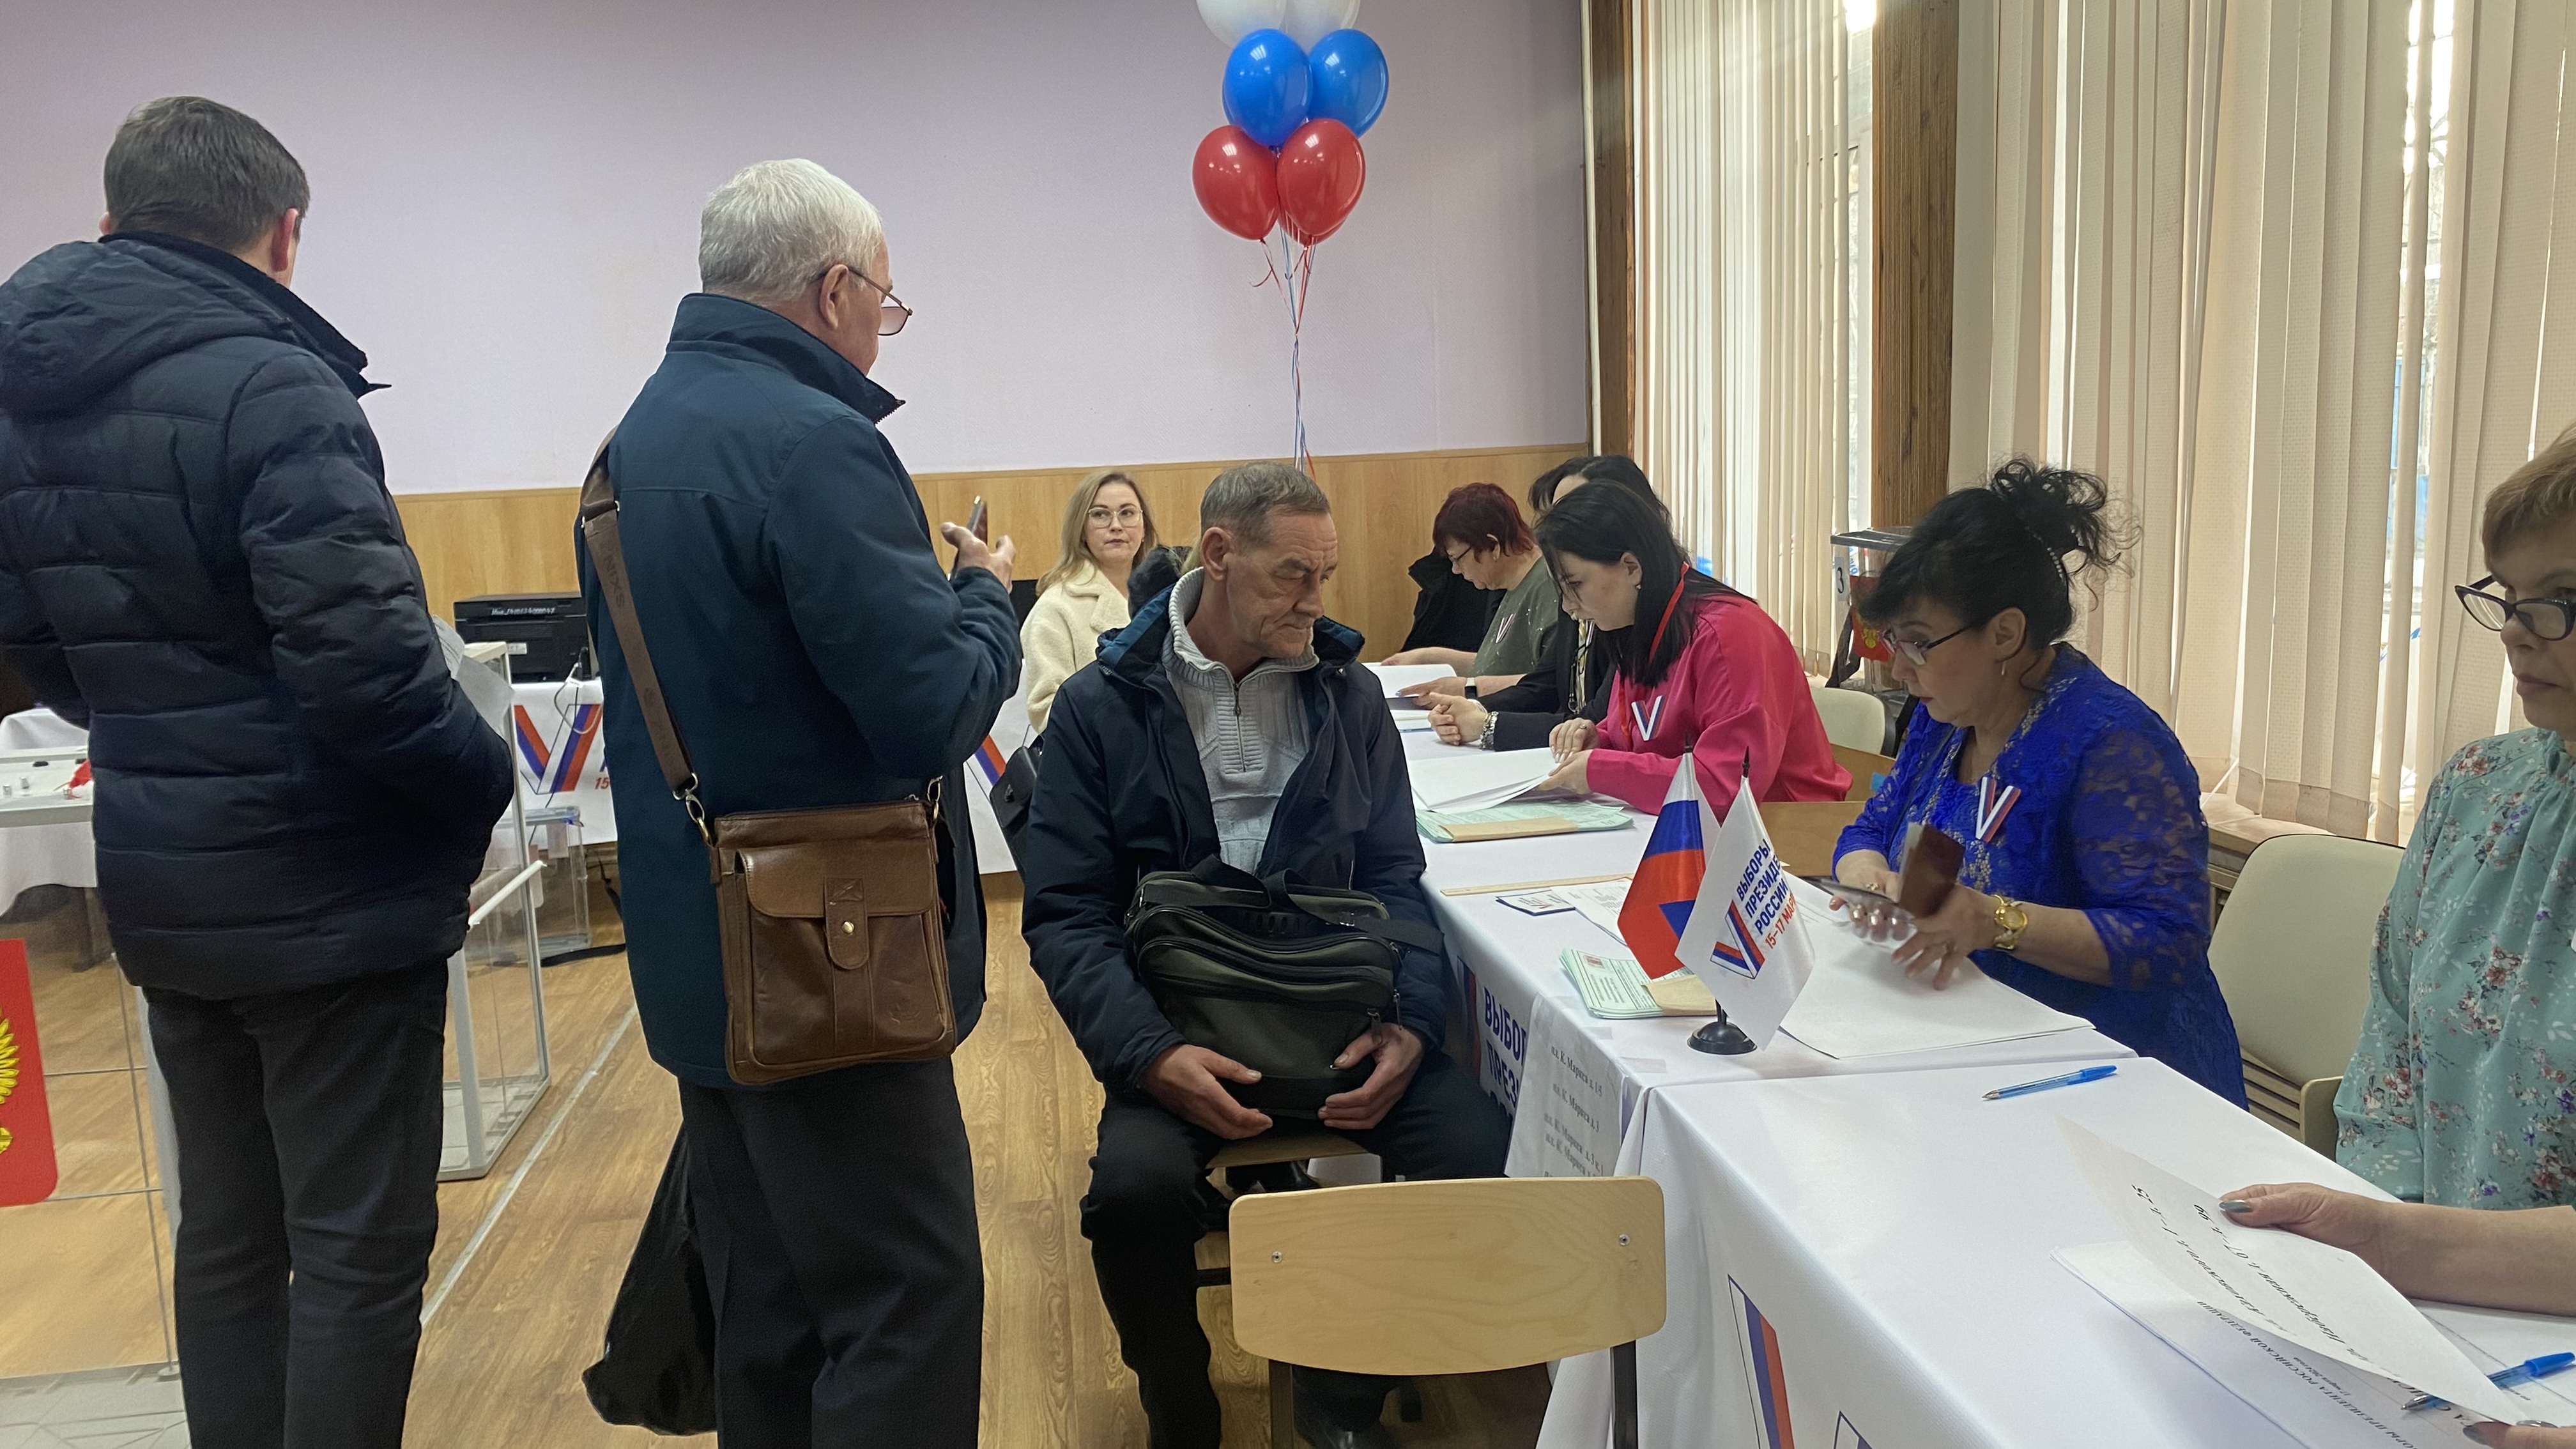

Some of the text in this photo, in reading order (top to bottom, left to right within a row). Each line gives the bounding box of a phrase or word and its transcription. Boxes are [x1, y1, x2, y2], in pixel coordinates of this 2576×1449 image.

[1736, 839, 1770, 901] ВЫБОРЫ
[1754, 878, 1788, 936] РОССИИ
[1567, 1057, 1588, 1084] Маркса
[2131, 1184, 2154, 1204] 25
[2193, 1204, 2214, 1223] 99
[2196, 1301, 2251, 1337] ФЕДЕРАЦИИ
[2257, 1271, 2346, 1344] Набережная
[2250, 1338, 2319, 1385] РОССИЙСКОЙ
[2319, 1386, 2388, 1430] ПРЕЗИДЕНТА
[2385, 1431, 2418, 1449] ОРЫ
